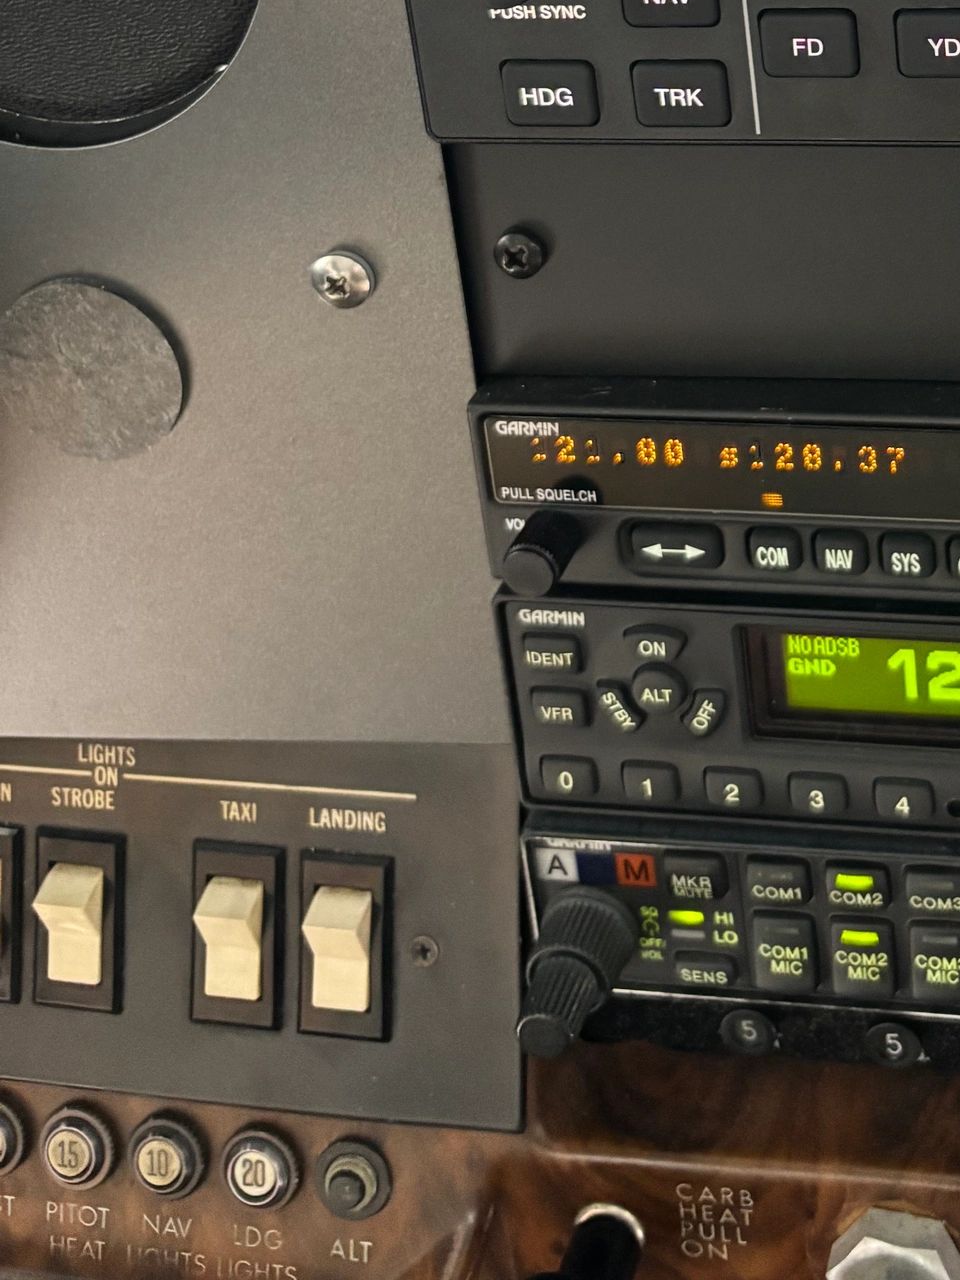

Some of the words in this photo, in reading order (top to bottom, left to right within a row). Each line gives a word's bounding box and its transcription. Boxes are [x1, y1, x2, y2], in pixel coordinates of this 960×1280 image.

[540, 5, 586, 20] SYNC
[792, 38, 824, 57] FD
[928, 38, 960, 57] YD
[519, 87, 574, 106] HDG
[654, 88, 703, 107] TRK
[495, 421, 560, 436] GARMIN
[501, 486, 535, 502] PULL
[537, 487, 597, 504] SQUELCH
[757, 546, 789, 567] COM
[825, 549, 853, 569] NAV
[891, 552, 921, 573] SYS
[519, 609, 585, 626] GARMIN
[526, 650, 573, 666] IDENT
[639, 640, 667, 657] ON
[641, 688, 672, 704] ALT
[541, 705, 573, 720] VFR
[77, 743, 136, 767] LIGHTS
[94, 766, 118, 787] ON
[51, 787, 115, 810] STROBE
[809, 789, 824, 810] 3
[220, 800, 258, 823] TAXI
[309, 808, 386, 833] LANDING
[752, 885, 802, 900] COM1
[830, 891, 883, 906] COM2
[714, 930, 738, 944] LO
[759, 943, 808, 960] COM1
[835, 950, 888, 967] COM2
[680, 969, 728, 984] SENS
[770, 960, 802, 975] MIC
[848, 966, 880, 981] MIC
[926, 970, 959, 984] MIC
[56, 1140, 79, 1170] 15
[676, 1183, 754, 1207] CARB
[46, 1201, 110, 1229] PITOT
[679, 1202, 753, 1226] HEAT
[143, 1214, 192, 1238] NAV
[681, 1221, 747, 1245] PULL
[50, 1236, 106, 1262] HEAT
[329, 1238, 373, 1264] ALT
[681, 1239, 728, 1261] ON
